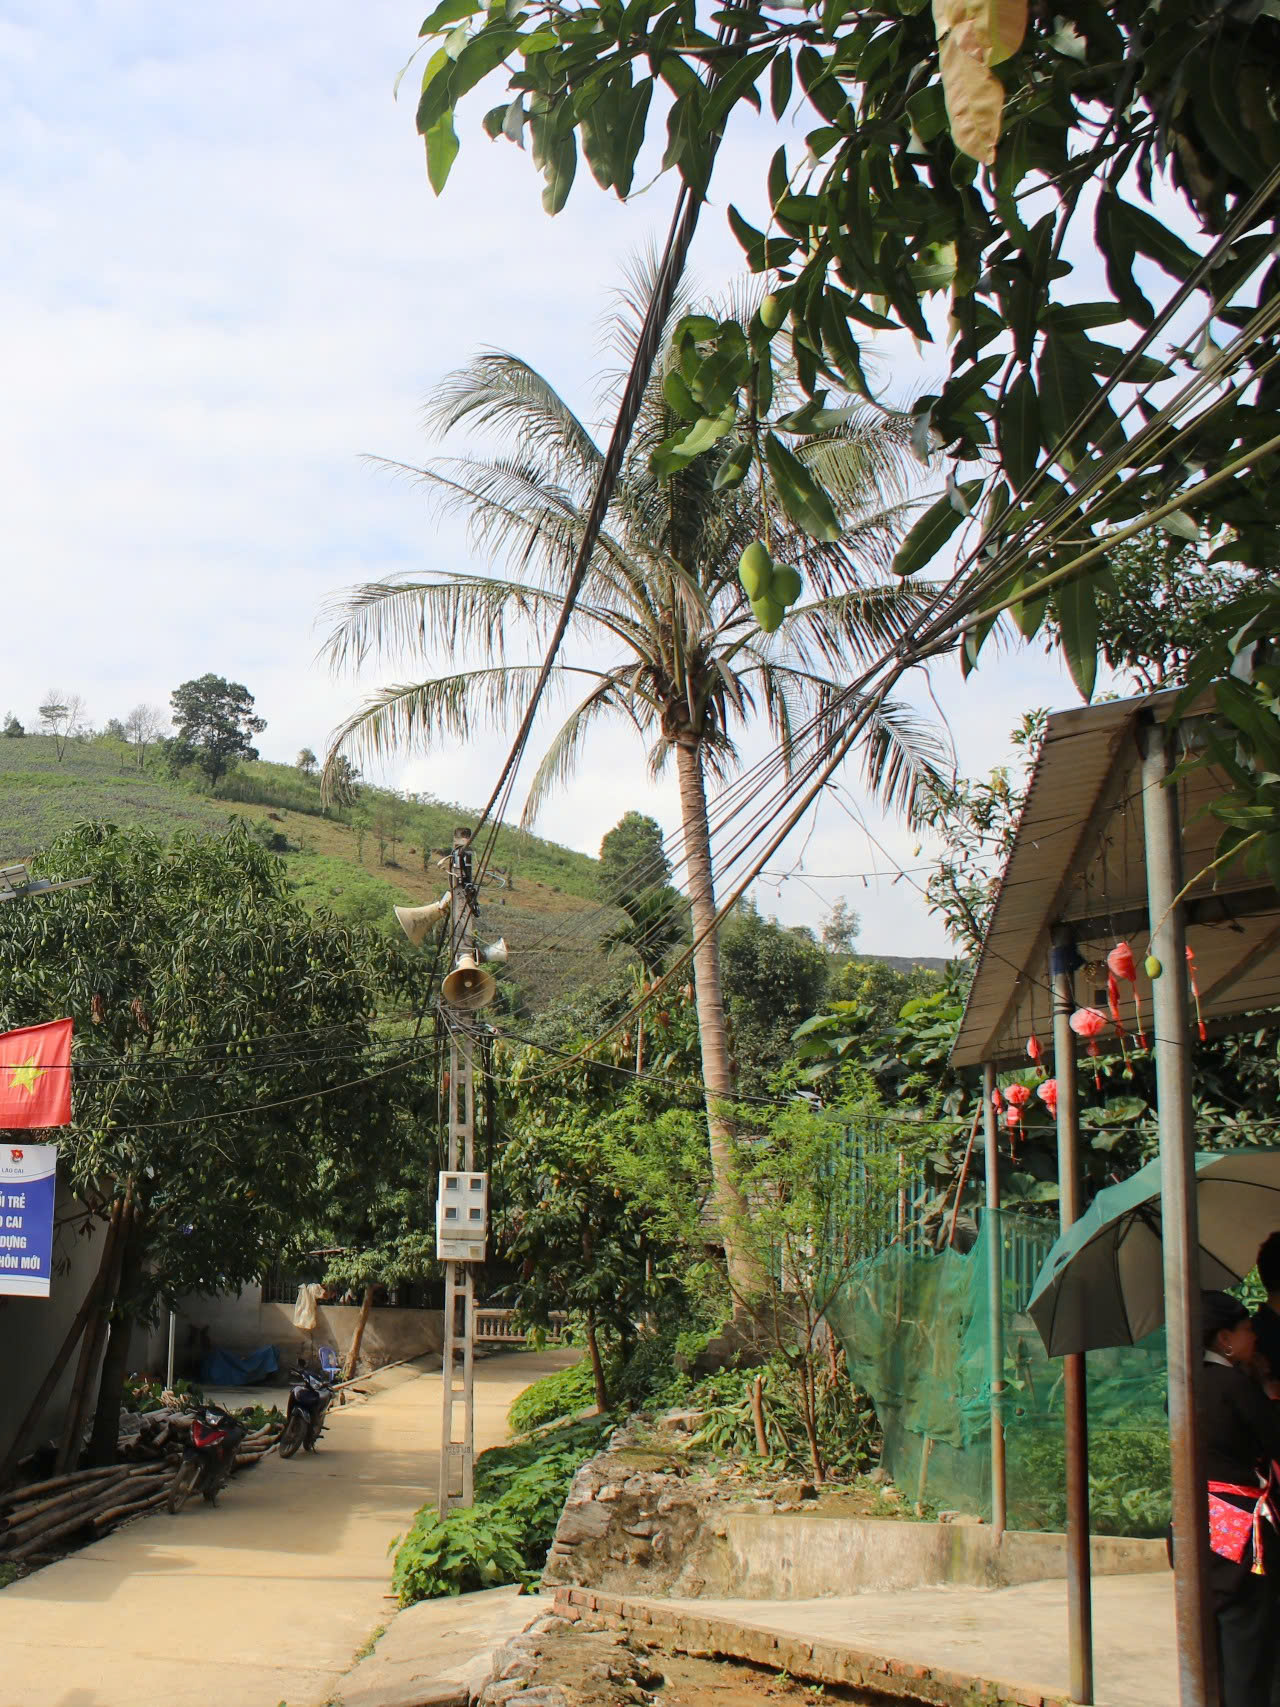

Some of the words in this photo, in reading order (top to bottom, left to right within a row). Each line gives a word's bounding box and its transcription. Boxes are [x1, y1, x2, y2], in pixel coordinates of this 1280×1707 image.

[8, 1192, 26, 1209] TRẺ
[5, 1215, 23, 1229] CAI
[0, 1234, 27, 1251] DỰNG
[20, 1254, 41, 1270] MỚI
